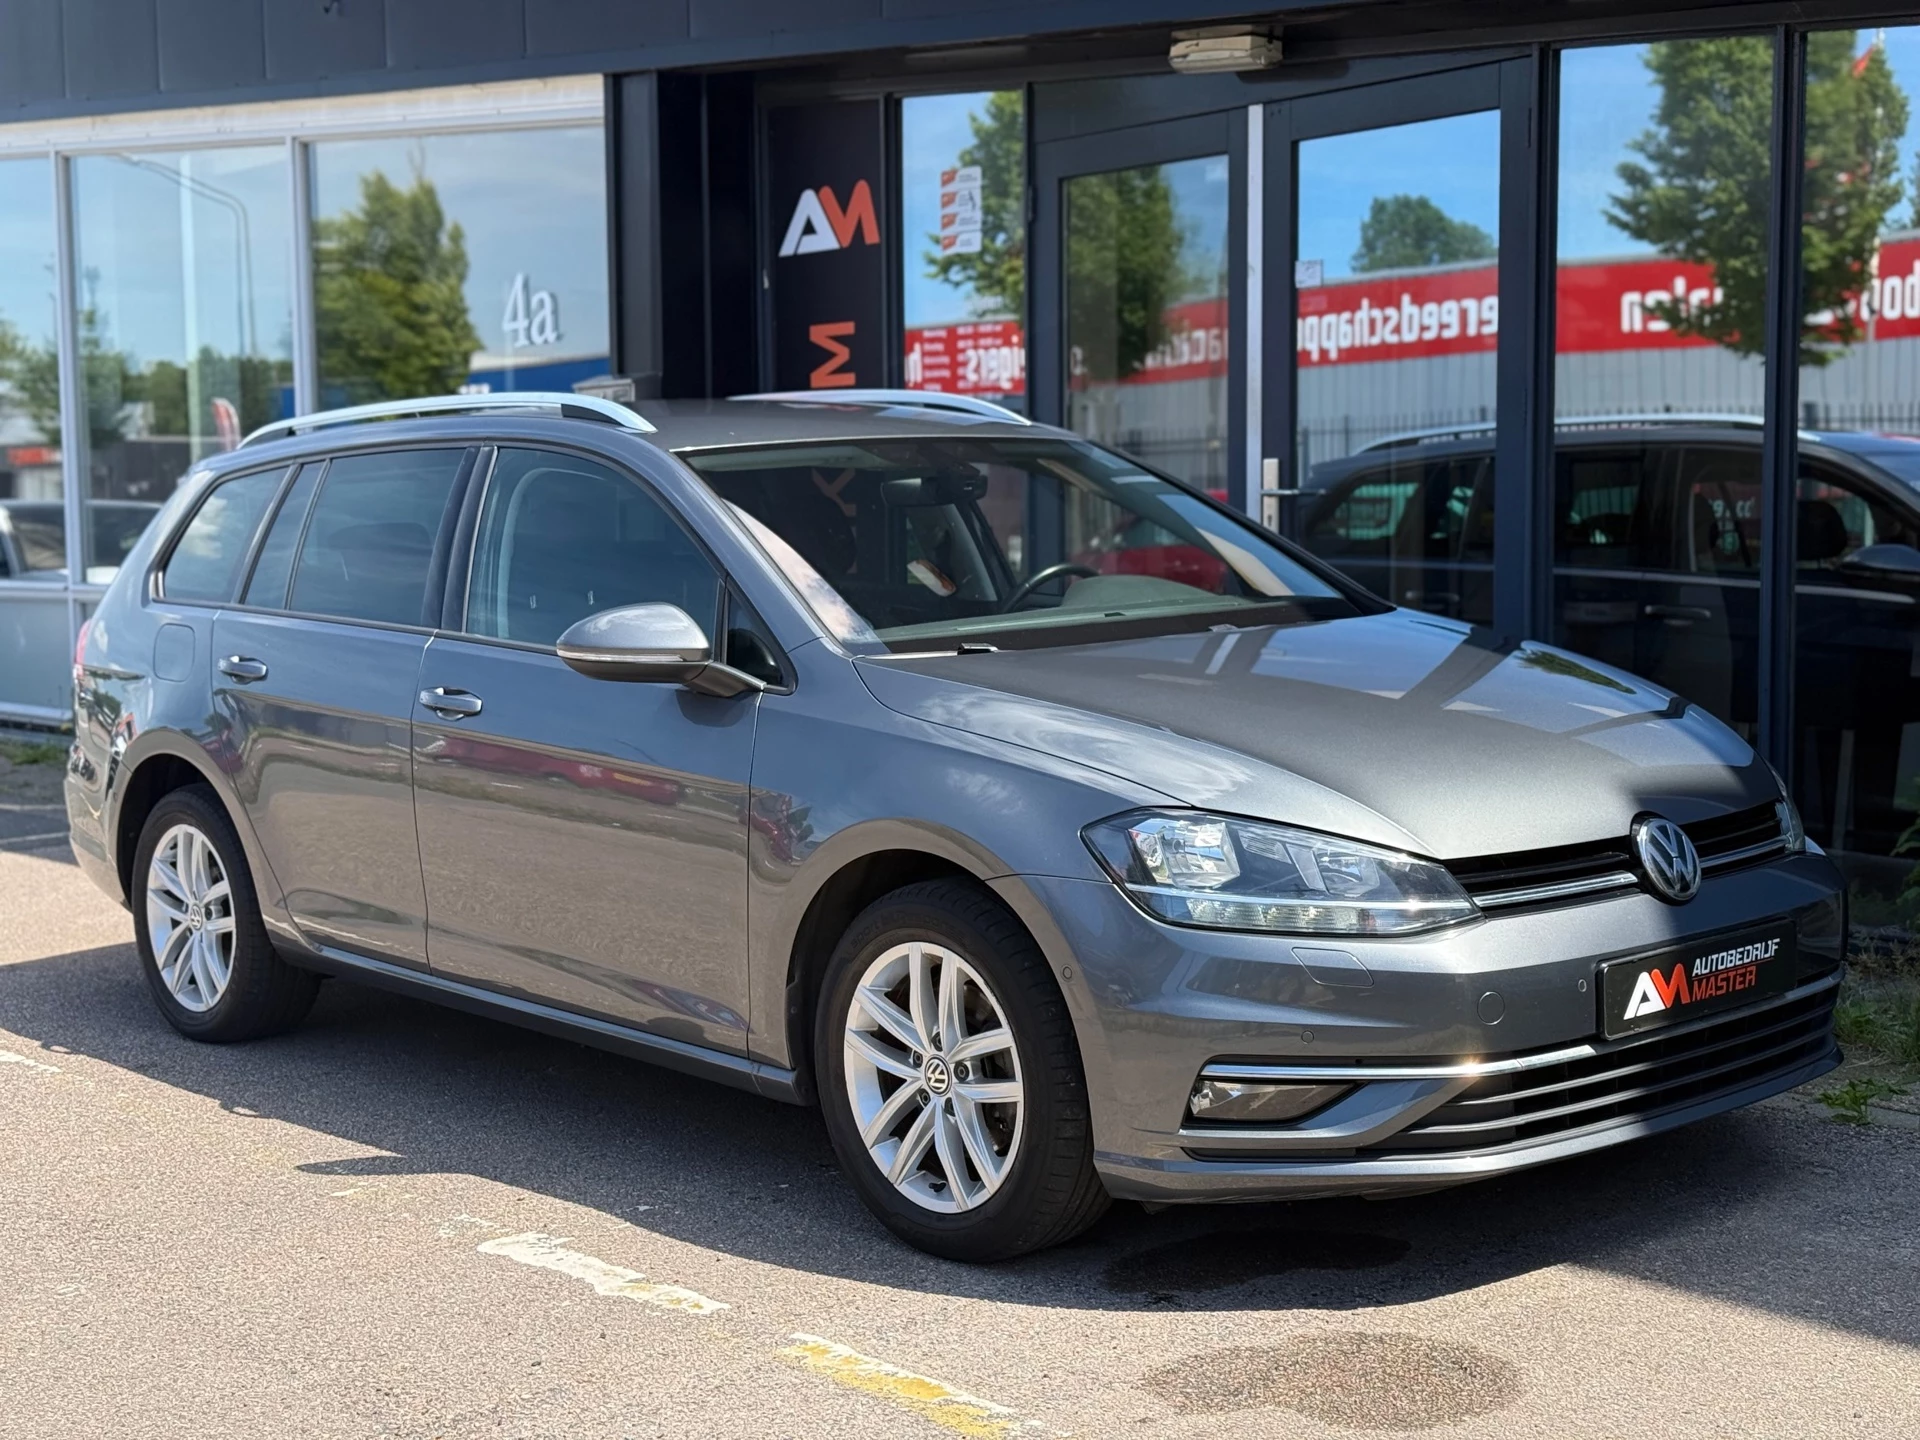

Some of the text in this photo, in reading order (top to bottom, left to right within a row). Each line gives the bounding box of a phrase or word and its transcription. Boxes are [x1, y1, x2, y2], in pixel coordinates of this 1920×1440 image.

[778, 178, 881, 258] AM
[502, 272, 558, 346] 4a
[1692, 938, 1780, 977] AUTOBEDRIJF
[1692, 966, 1757, 1001] MASTER
[1623, 963, 1691, 1020] AM
